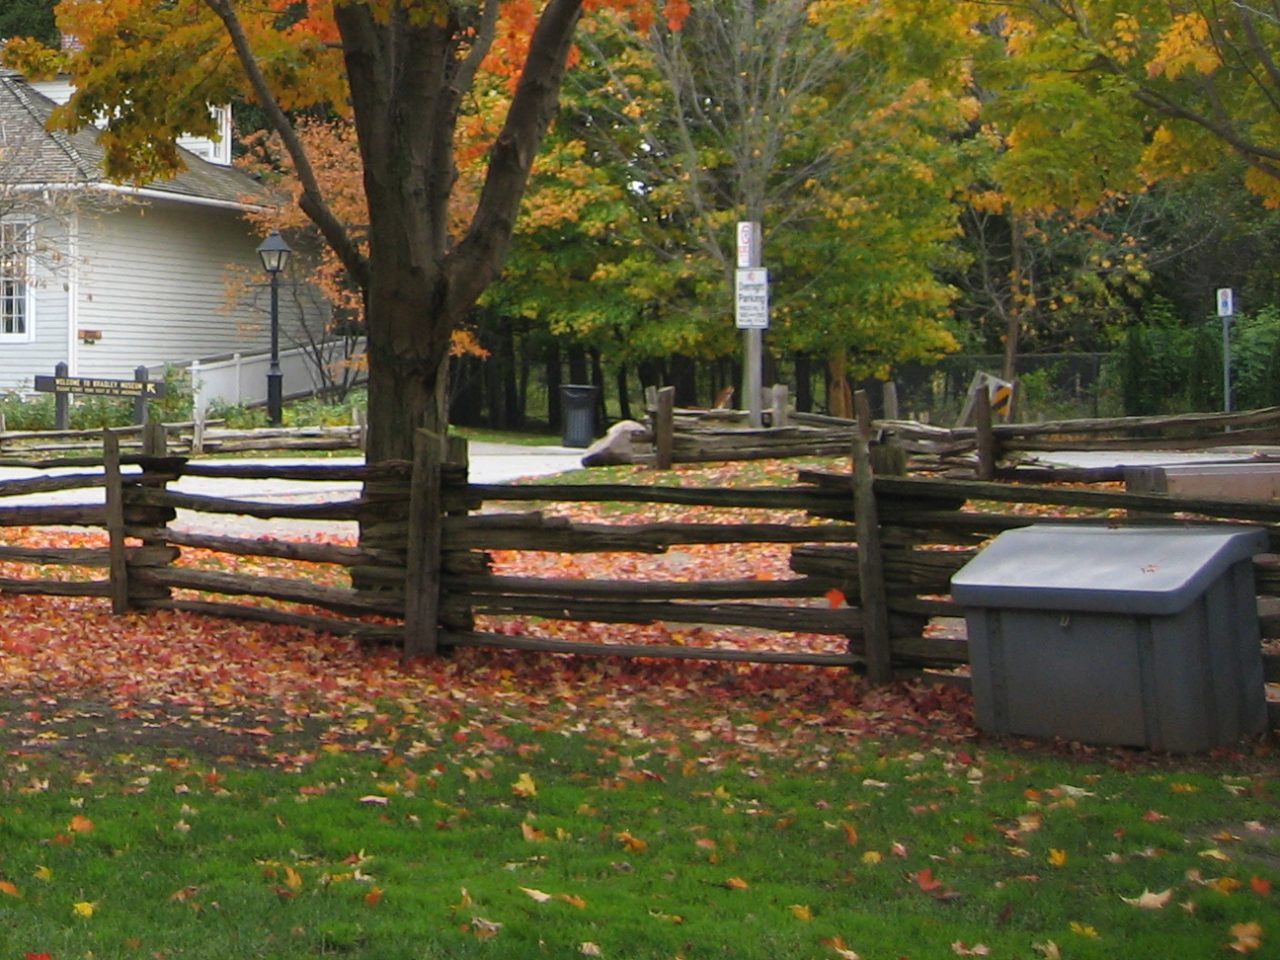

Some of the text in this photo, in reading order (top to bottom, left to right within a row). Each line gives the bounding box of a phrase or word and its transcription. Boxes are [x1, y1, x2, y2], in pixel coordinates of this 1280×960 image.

[738, 294, 766, 305] Parking
[56, 378, 81, 386] WELCOME
[93, 380, 118, 388] BRADLEY
[121, 382, 143, 390] MUSEUM
